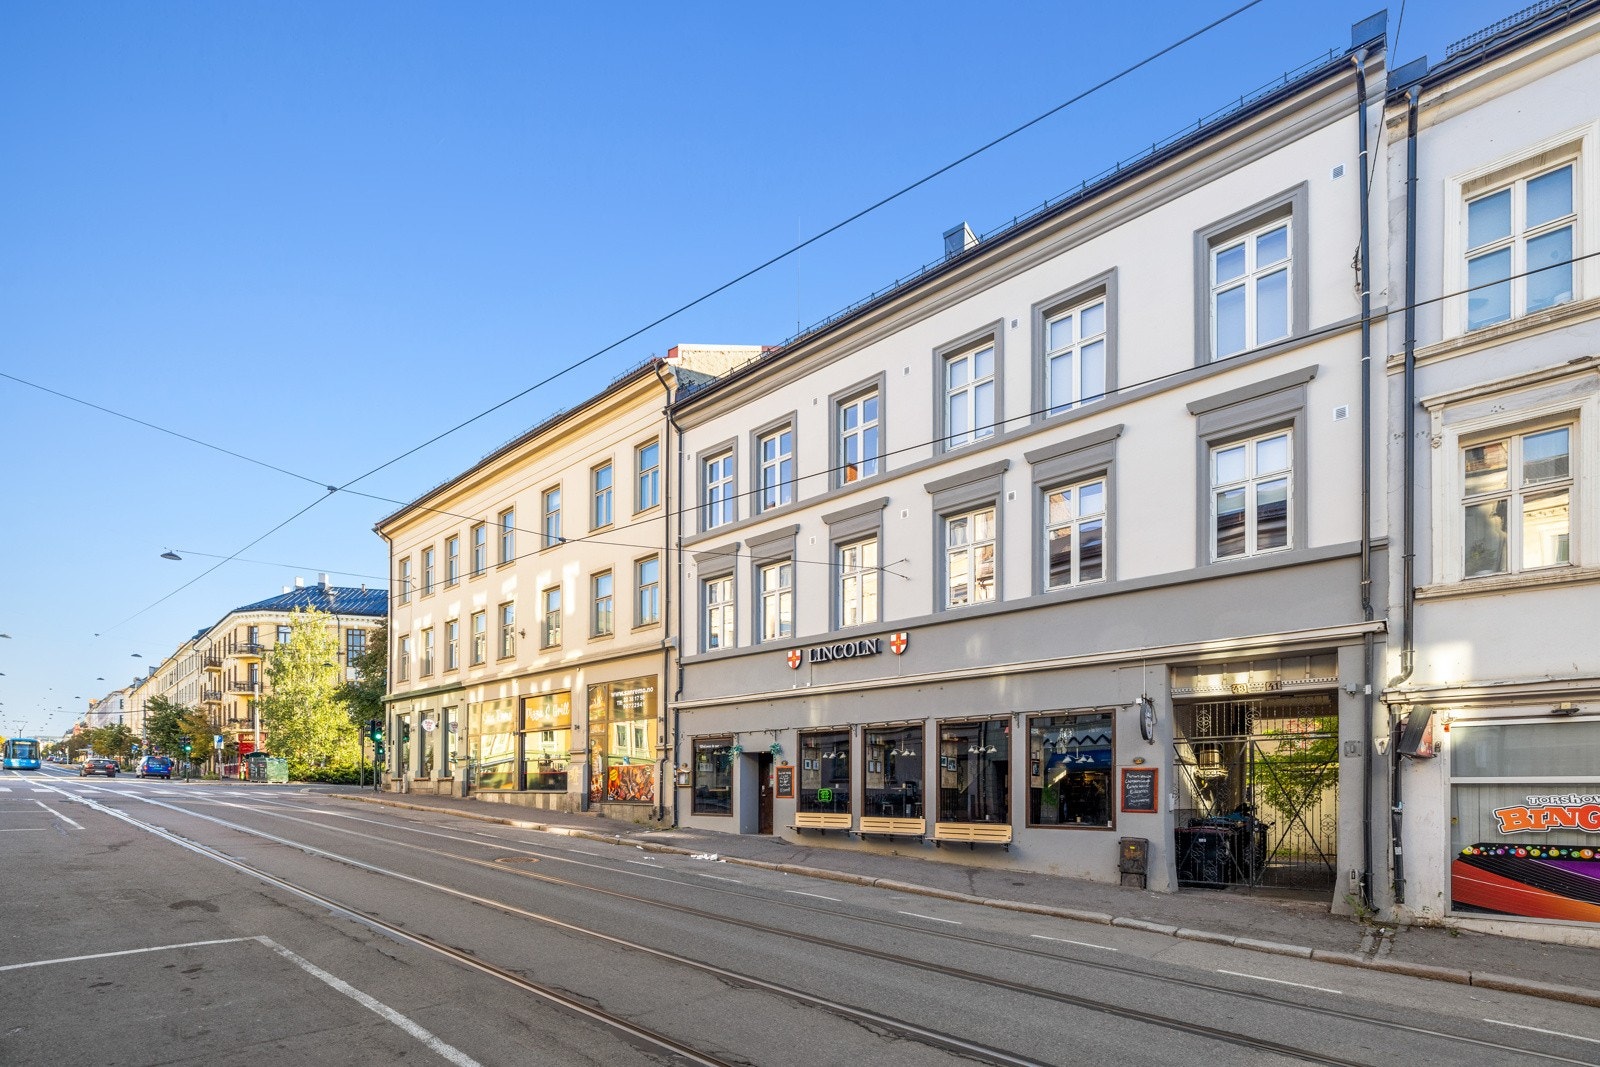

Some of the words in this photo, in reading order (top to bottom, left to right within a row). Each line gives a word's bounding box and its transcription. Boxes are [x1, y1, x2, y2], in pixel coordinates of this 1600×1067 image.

[808, 638, 881, 663] LINCOLN
[1268, 682, 1280, 690] 41
[552, 701, 570, 717] Grill
